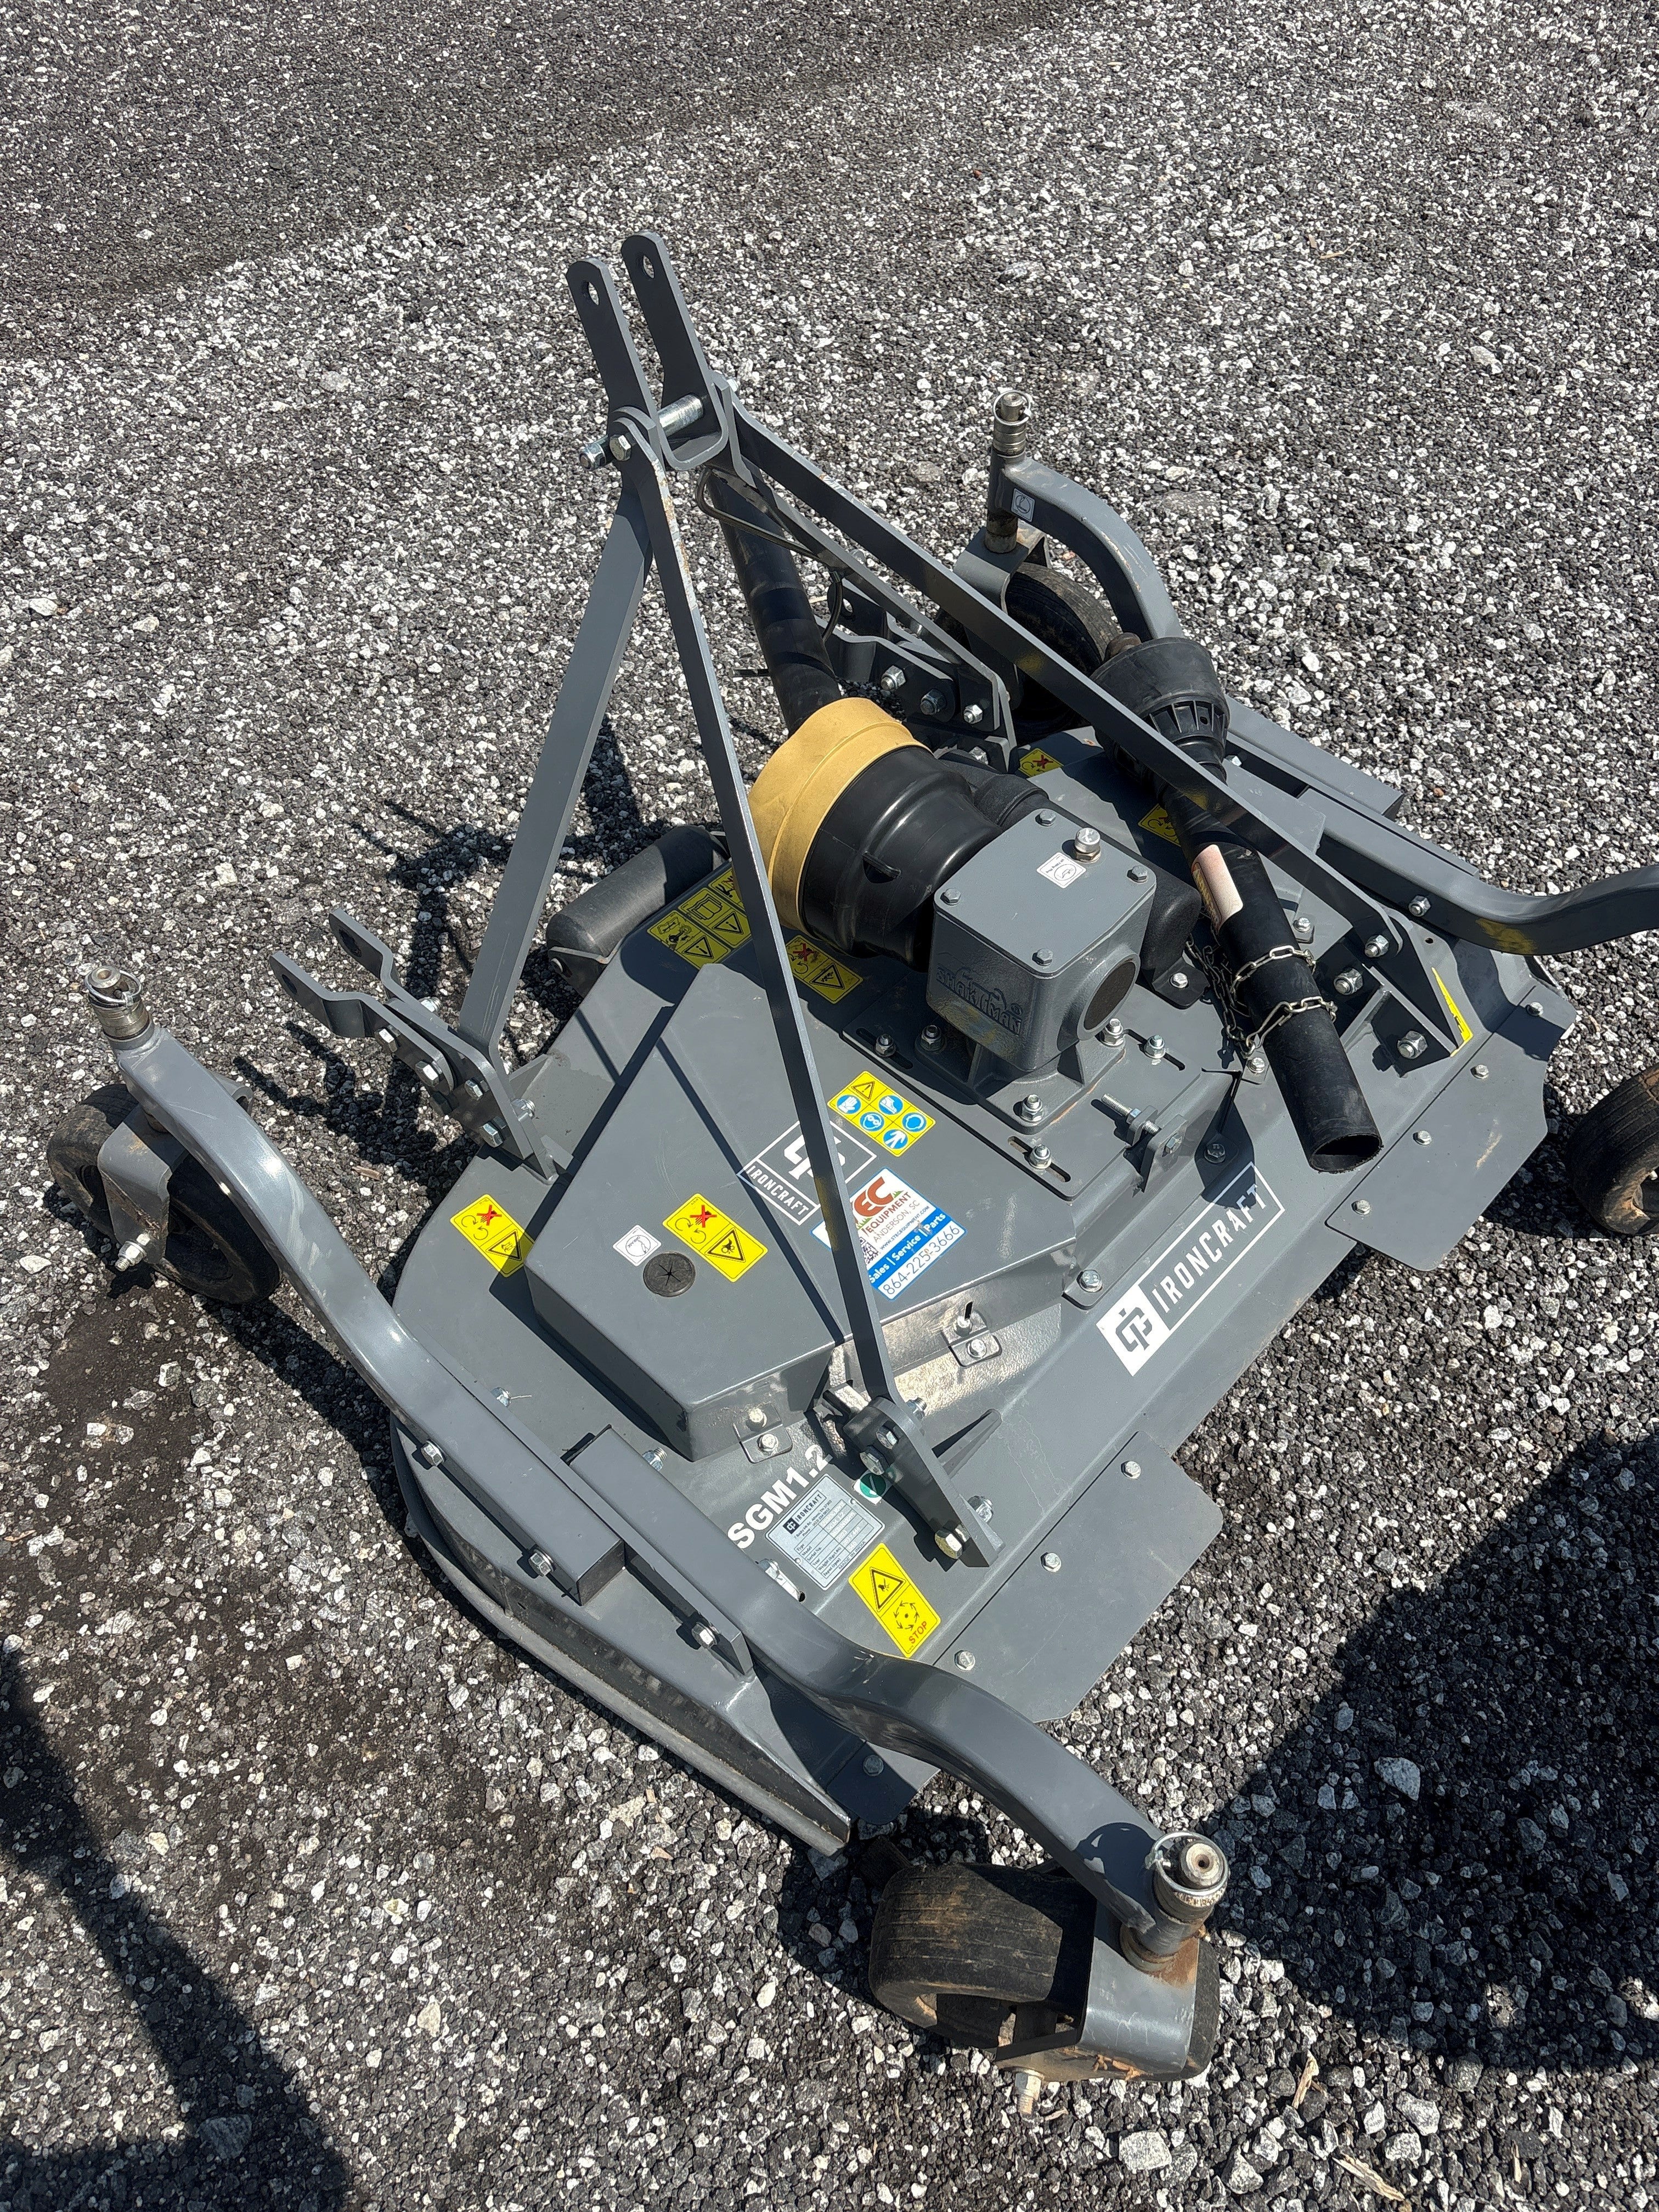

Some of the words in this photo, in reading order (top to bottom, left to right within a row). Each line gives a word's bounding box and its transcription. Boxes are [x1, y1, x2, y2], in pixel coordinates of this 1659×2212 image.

[746, 1165, 809, 1215] IRONCRAFT
[865, 1192, 911, 1233] EQUIPMENT
[873, 1209, 911, 1243] ANDERSON,
[909, 1200, 920, 1210] SC
[892, 1235, 921, 1261] Service
[923, 1214, 946, 1232] Parts
[883, 1225, 960, 1294] 864-225-3666
[1152, 1184, 1266, 1313] IRONCRAFT
[728, 1444, 833, 1549] SGM1.2
[795, 1494, 822, 1522] IRONCRAFT
[909, 1621, 927, 1644] STOP
